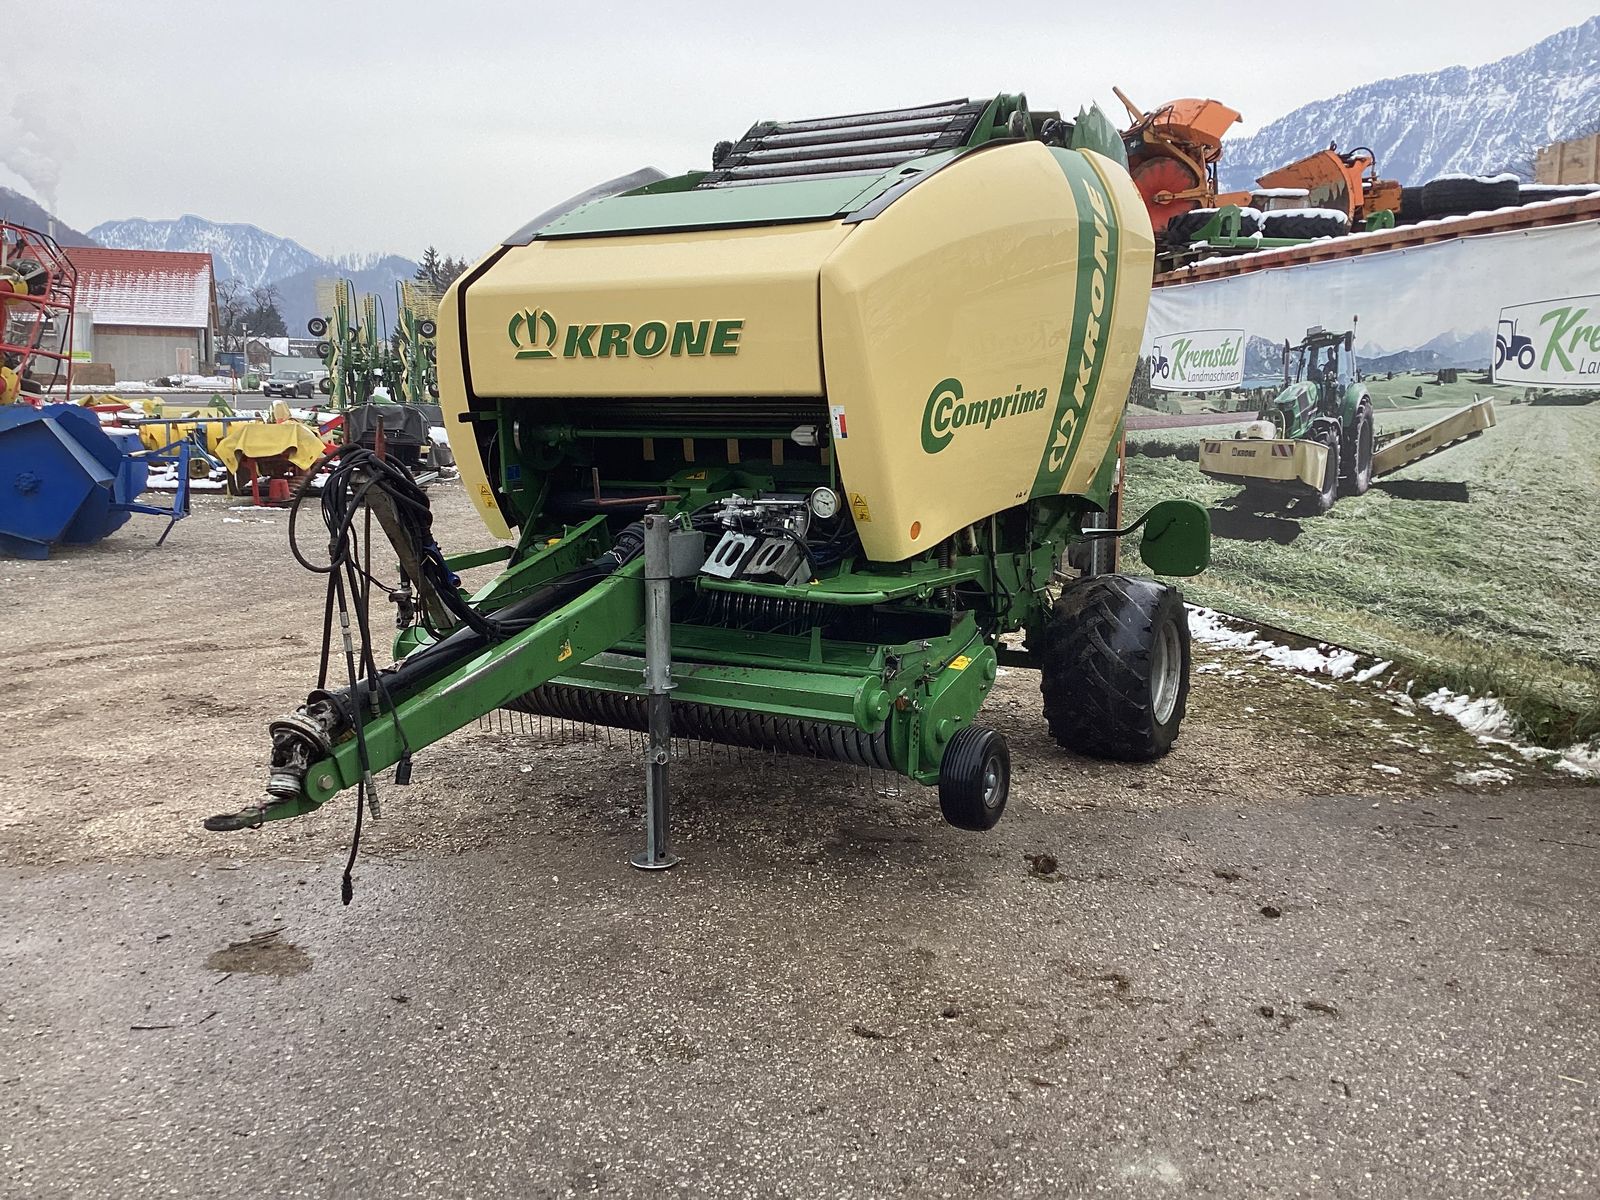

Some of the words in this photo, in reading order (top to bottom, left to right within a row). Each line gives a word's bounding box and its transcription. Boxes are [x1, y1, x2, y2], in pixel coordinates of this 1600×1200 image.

[1073, 178, 1110, 409] KRONE
[562, 318, 745, 358] KRONE
[1171, 336, 1242, 381] Kremstal
[1187, 370, 1239, 382] Landmaschinen
[921, 377, 1048, 454] Comprima
